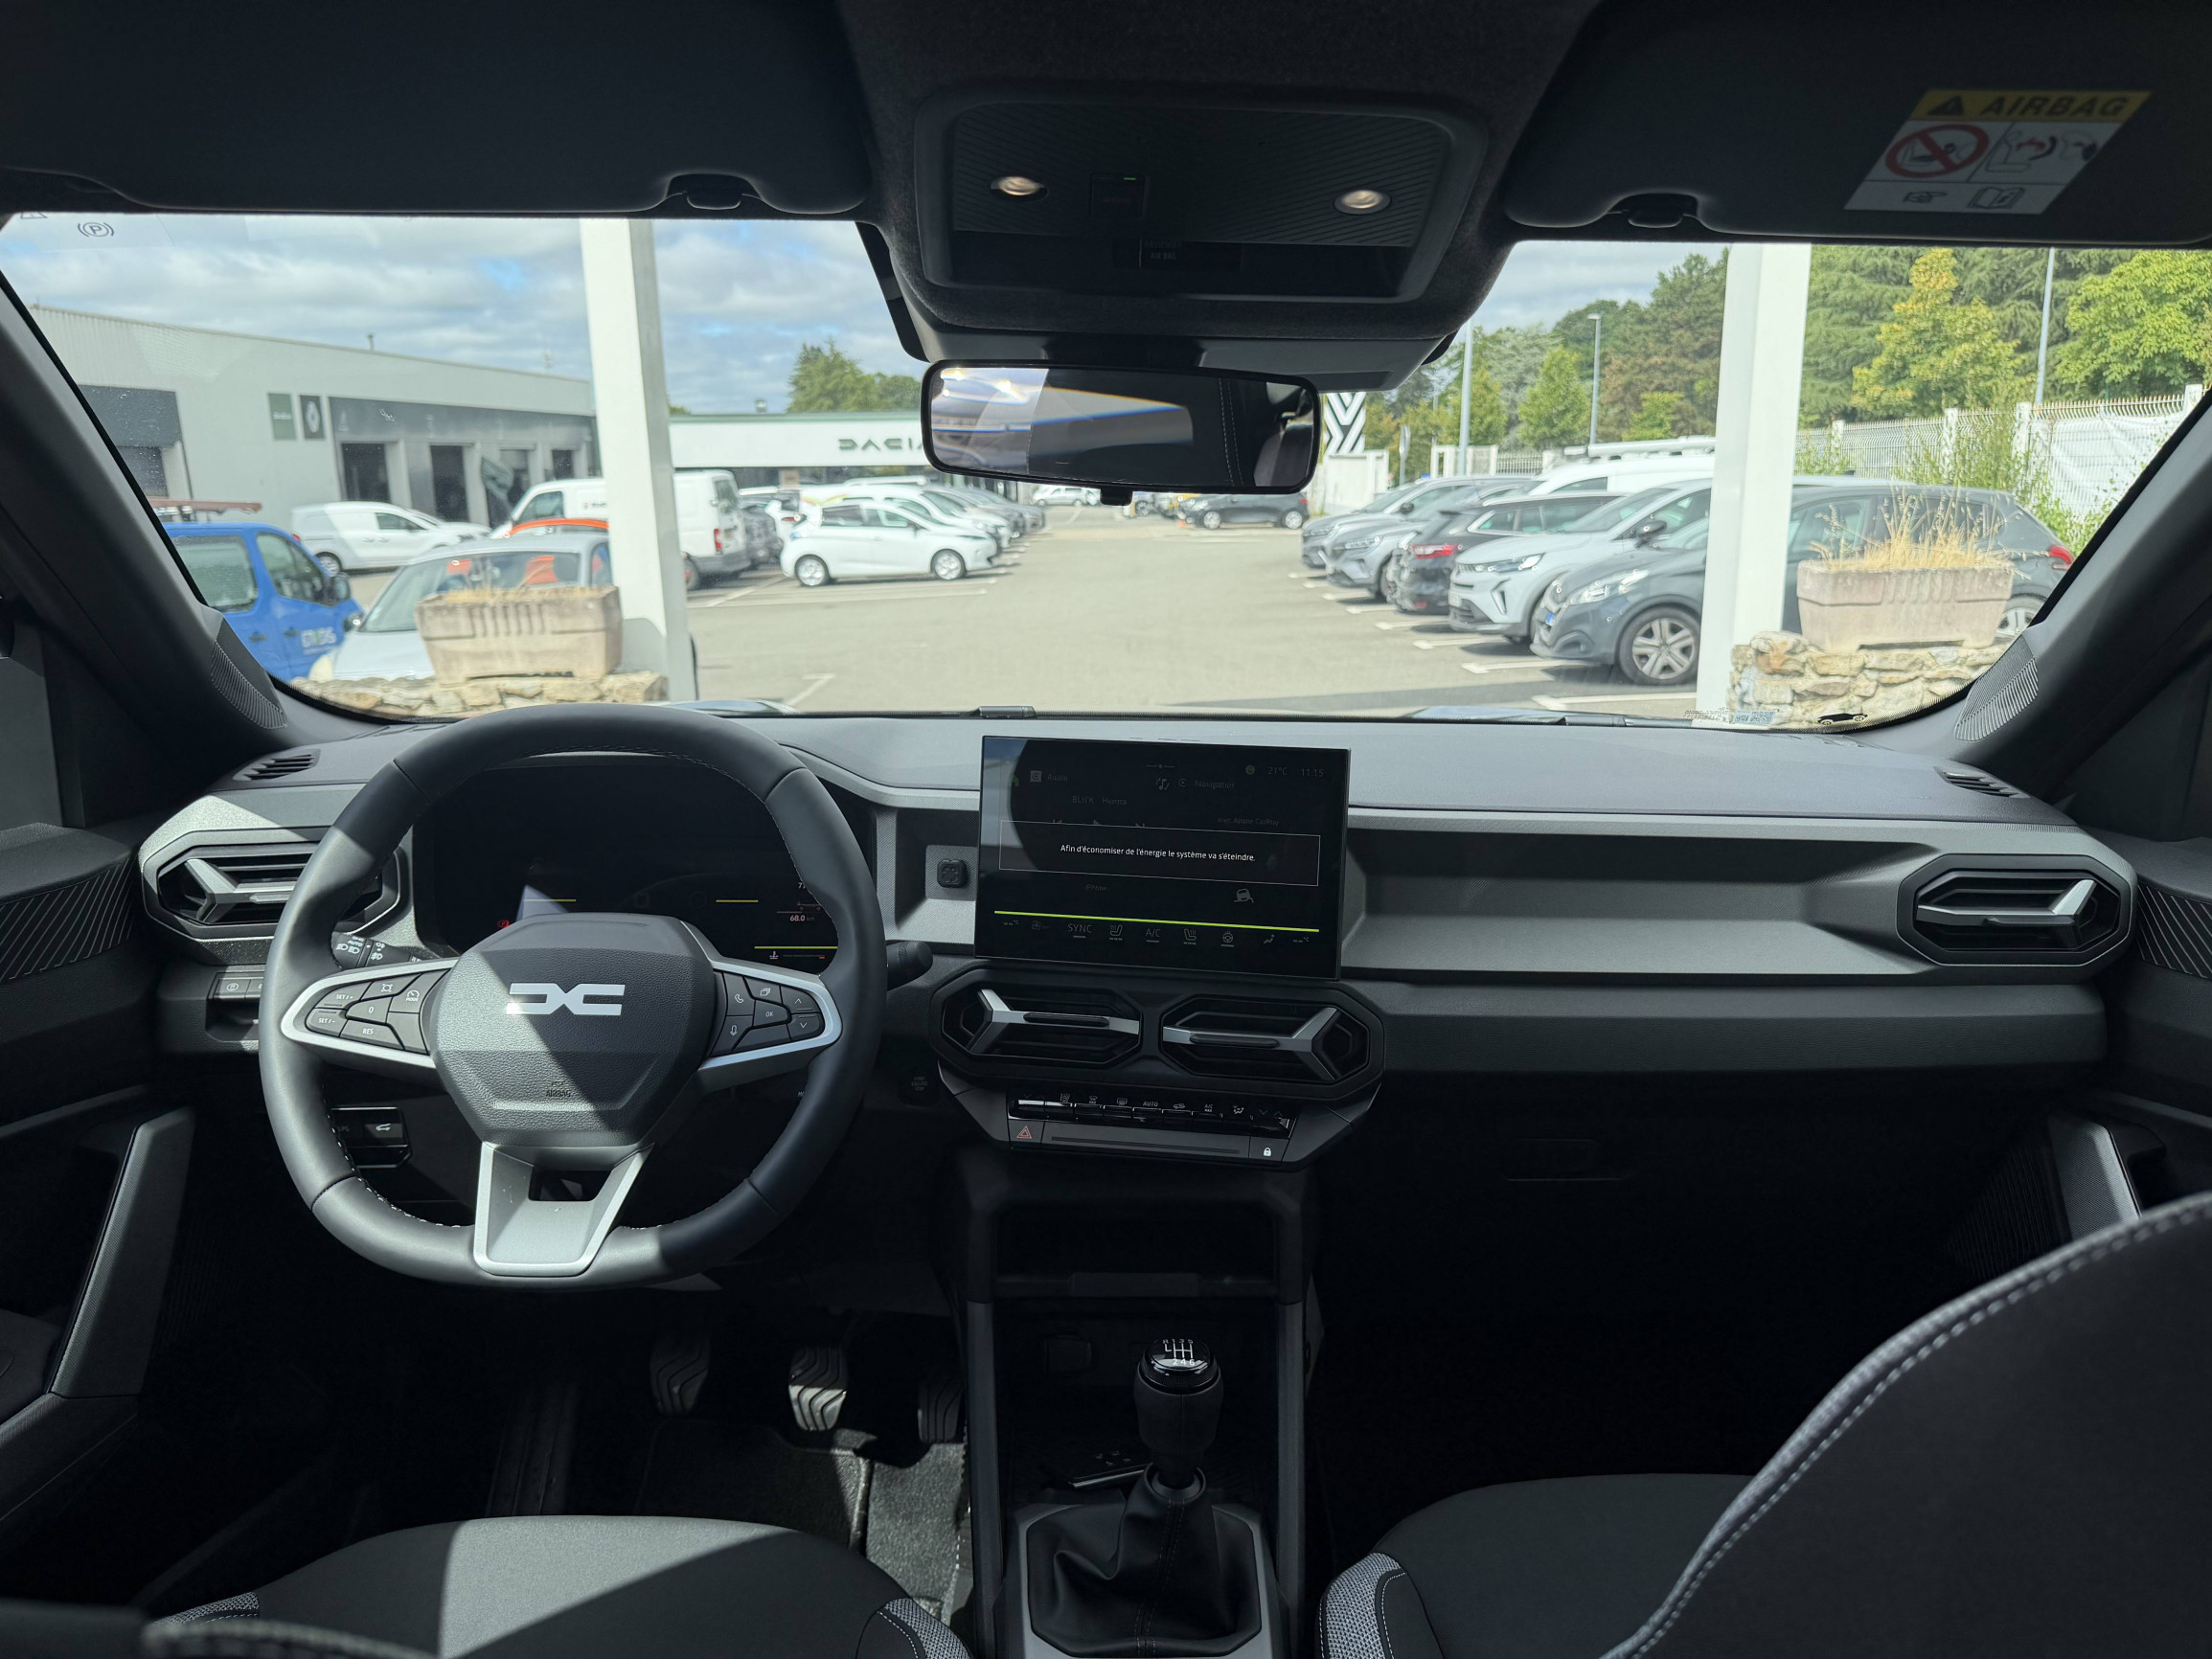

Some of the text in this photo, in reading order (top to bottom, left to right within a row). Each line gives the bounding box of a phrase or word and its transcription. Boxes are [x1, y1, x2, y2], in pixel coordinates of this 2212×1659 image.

[1979, 95, 2131, 117] AIRBAG
[838, 438, 923, 451] DACI
[1301, 768, 1324, 777] 11:15
[1176, 851, 1207, 860] système
[789, 914, 806, 922] 68.0
[1067, 922, 1094, 934] SYNC
[1145, 928, 1162, 938] A/C
